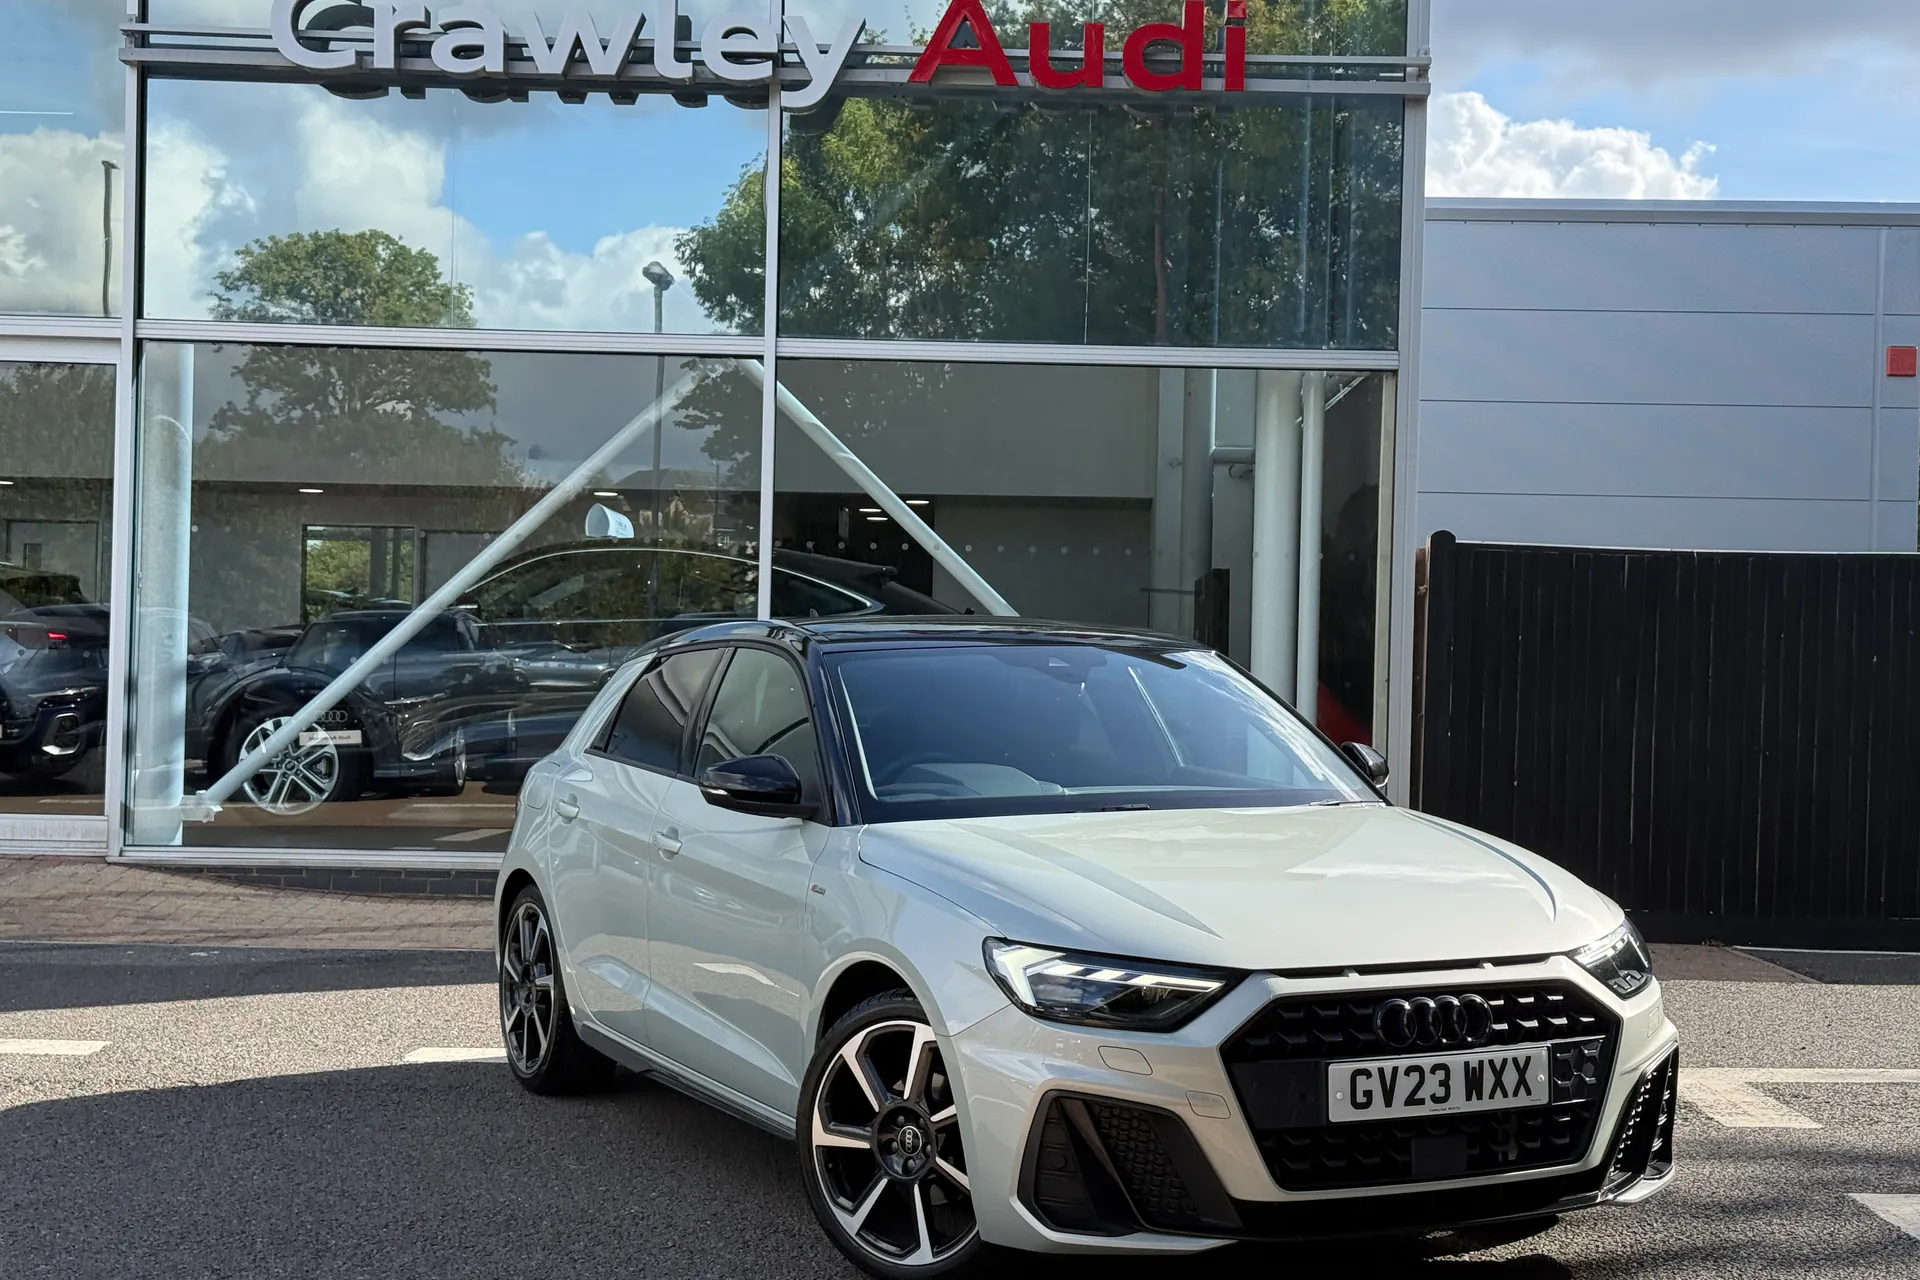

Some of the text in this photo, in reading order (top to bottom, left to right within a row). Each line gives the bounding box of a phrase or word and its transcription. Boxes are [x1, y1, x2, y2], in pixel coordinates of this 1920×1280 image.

[270, 0, 1247, 108] Crawley Audi
[1350, 1055, 1532, 1110] GV23 WXX
